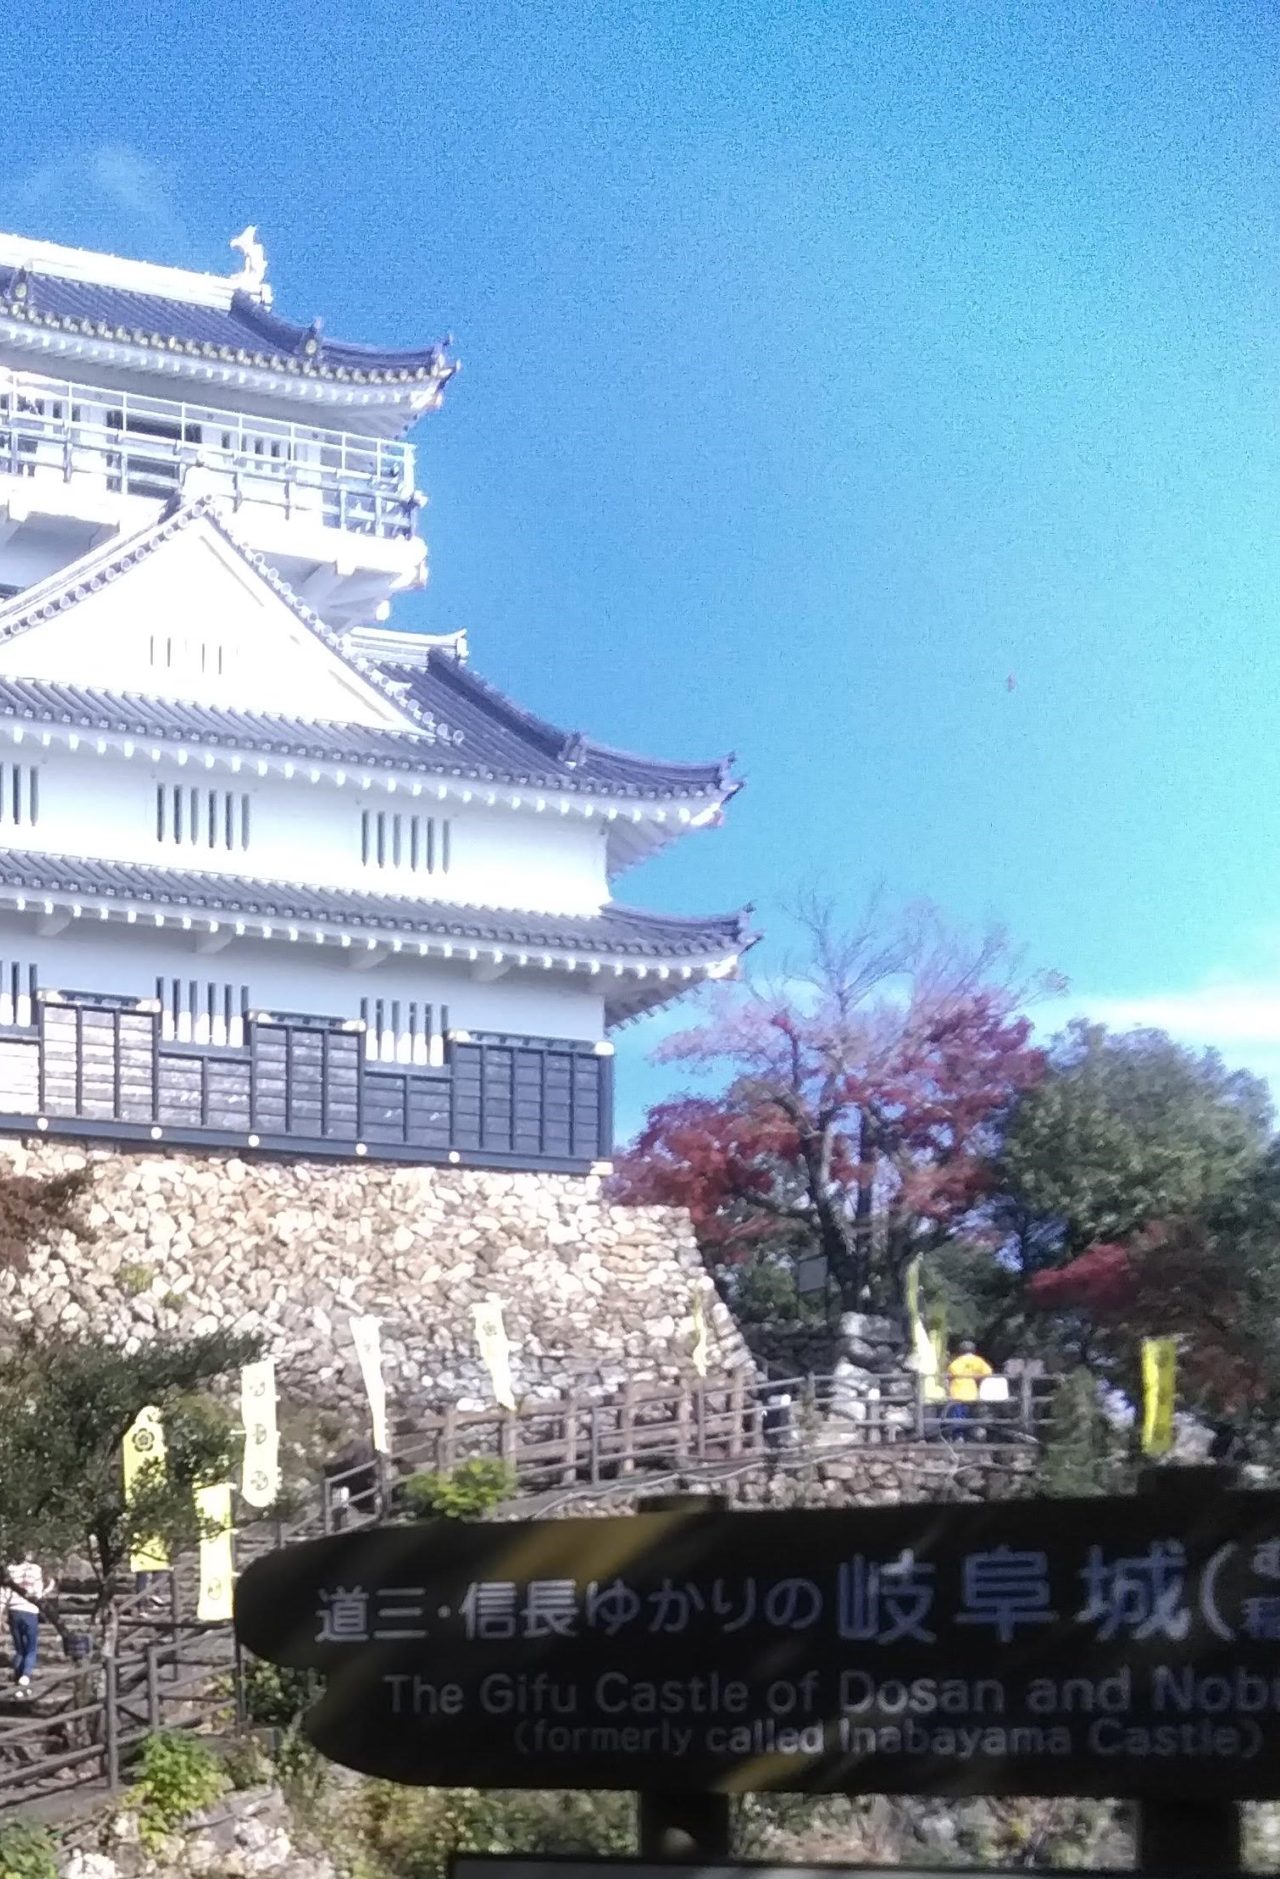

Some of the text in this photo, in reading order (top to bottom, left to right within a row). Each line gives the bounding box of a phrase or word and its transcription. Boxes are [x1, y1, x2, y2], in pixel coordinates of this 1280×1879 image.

[382, 1673, 465, 1715] The
[479, 1672, 577, 1715] Gifu
[595, 1671, 749, 1714] Castle
[766, 1669, 819, 1714] of
[839, 1668, 1006, 1714] Dosan
[1024, 1664, 1131, 1713] and
[514, 1717, 1264, 1759] (formerly called Inabayama Castle)
